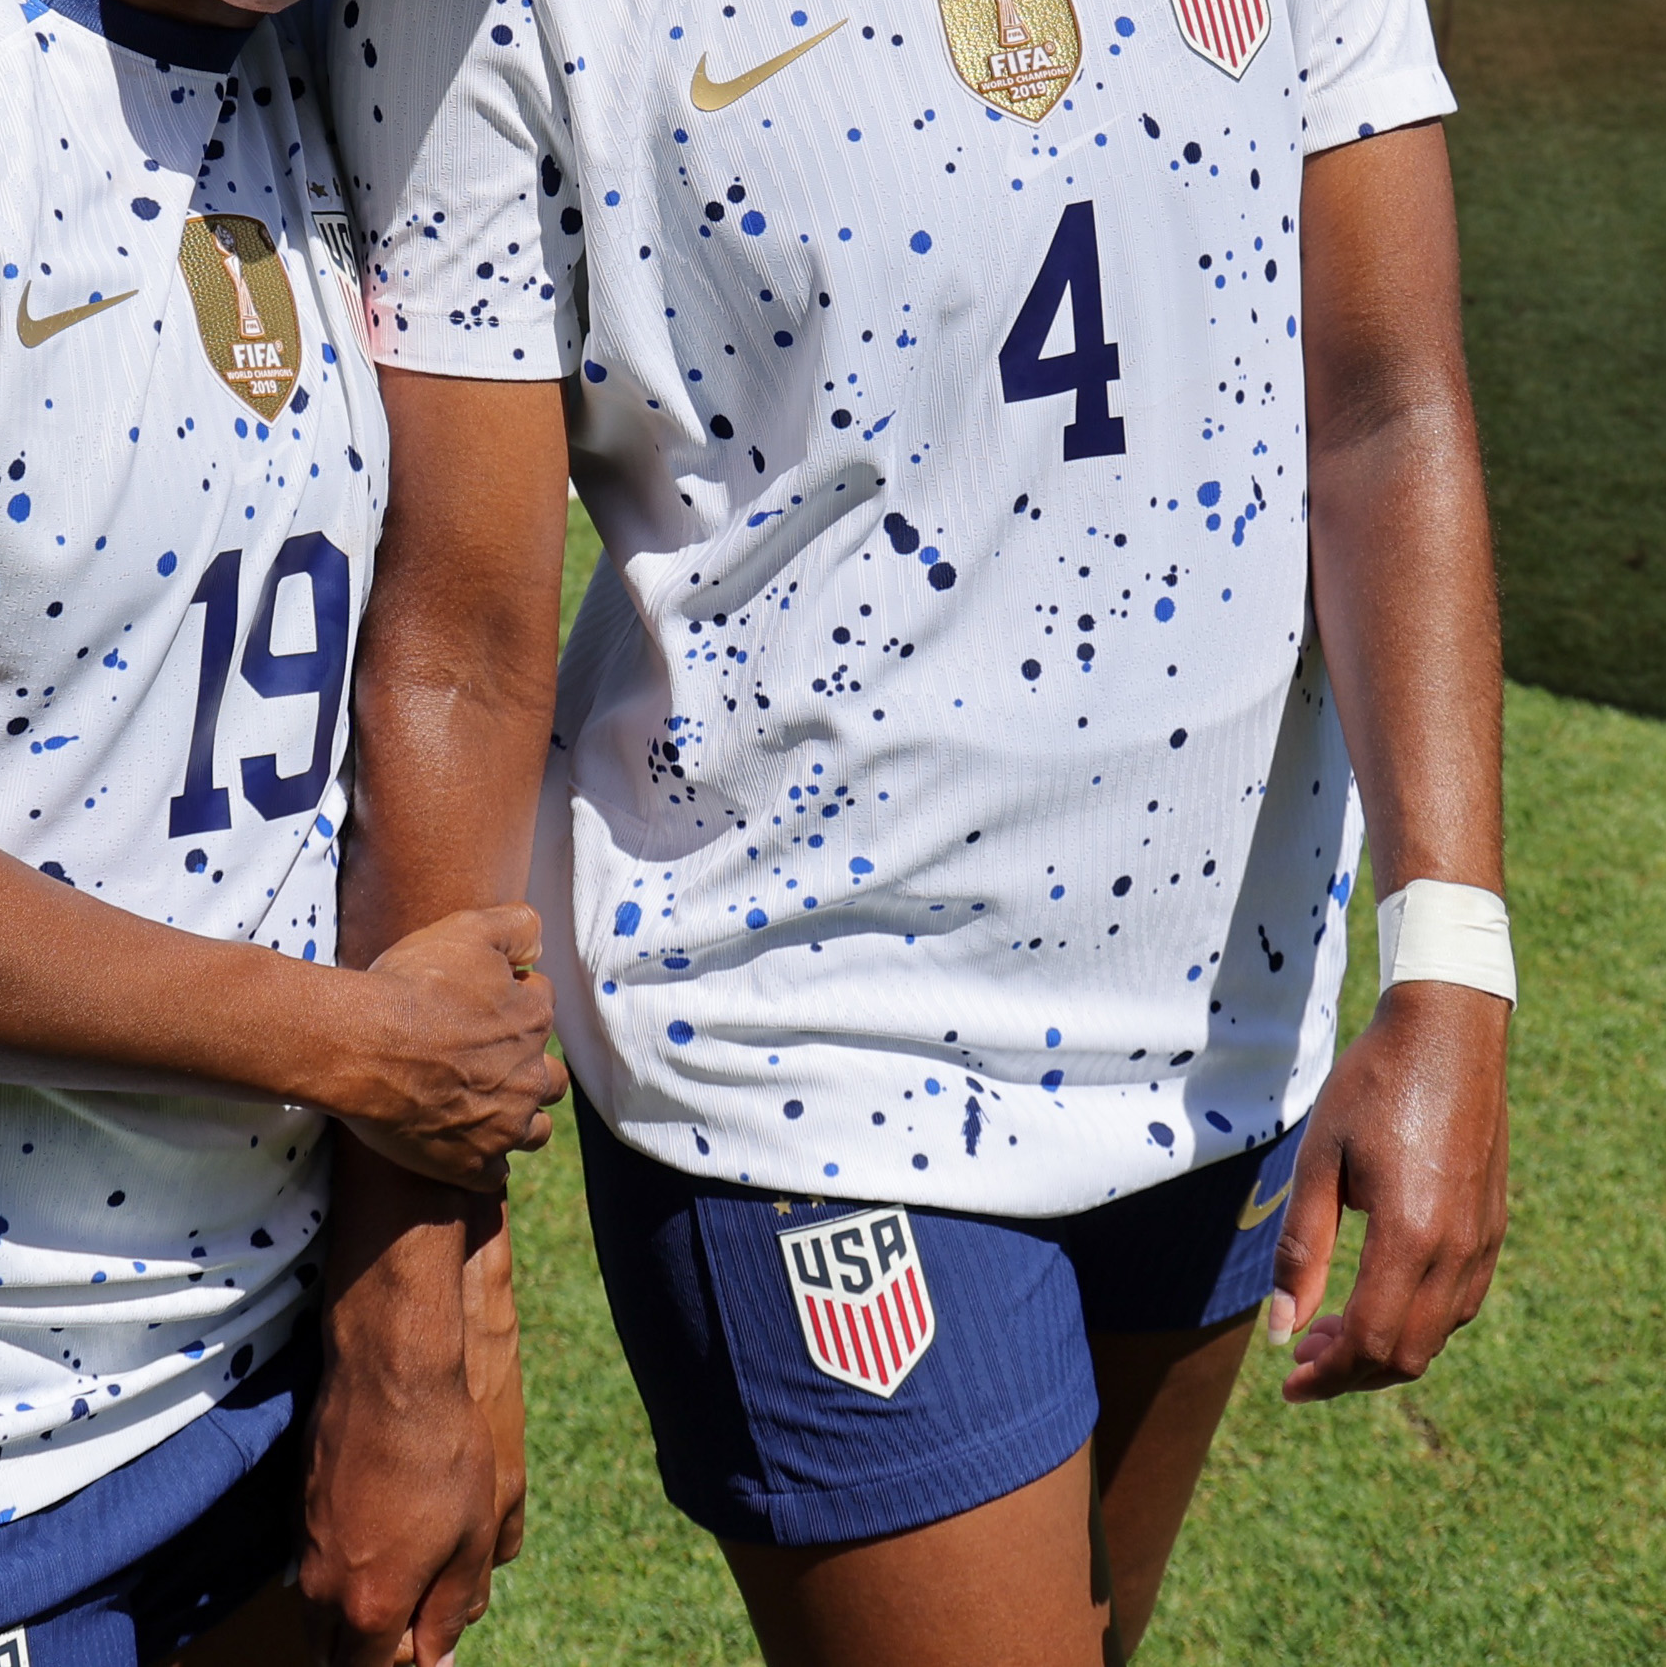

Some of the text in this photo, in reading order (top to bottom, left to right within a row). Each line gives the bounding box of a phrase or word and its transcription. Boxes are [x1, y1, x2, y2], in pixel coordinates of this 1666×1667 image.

[989, 46, 1054, 78] FIFA
[981, 67, 1069, 91] WORLD CHAMPIONS
[1010, 82, 1047, 100] 2019
[319, 222, 358, 286] US
[998, 199, 1127, 462] 4
[232, 343, 281, 368] FIFA
[226, 368, 294, 380] WORLD CHAMPIONS
[250, 380, 278, 395] 2019
[168, 530, 350, 839] 19
